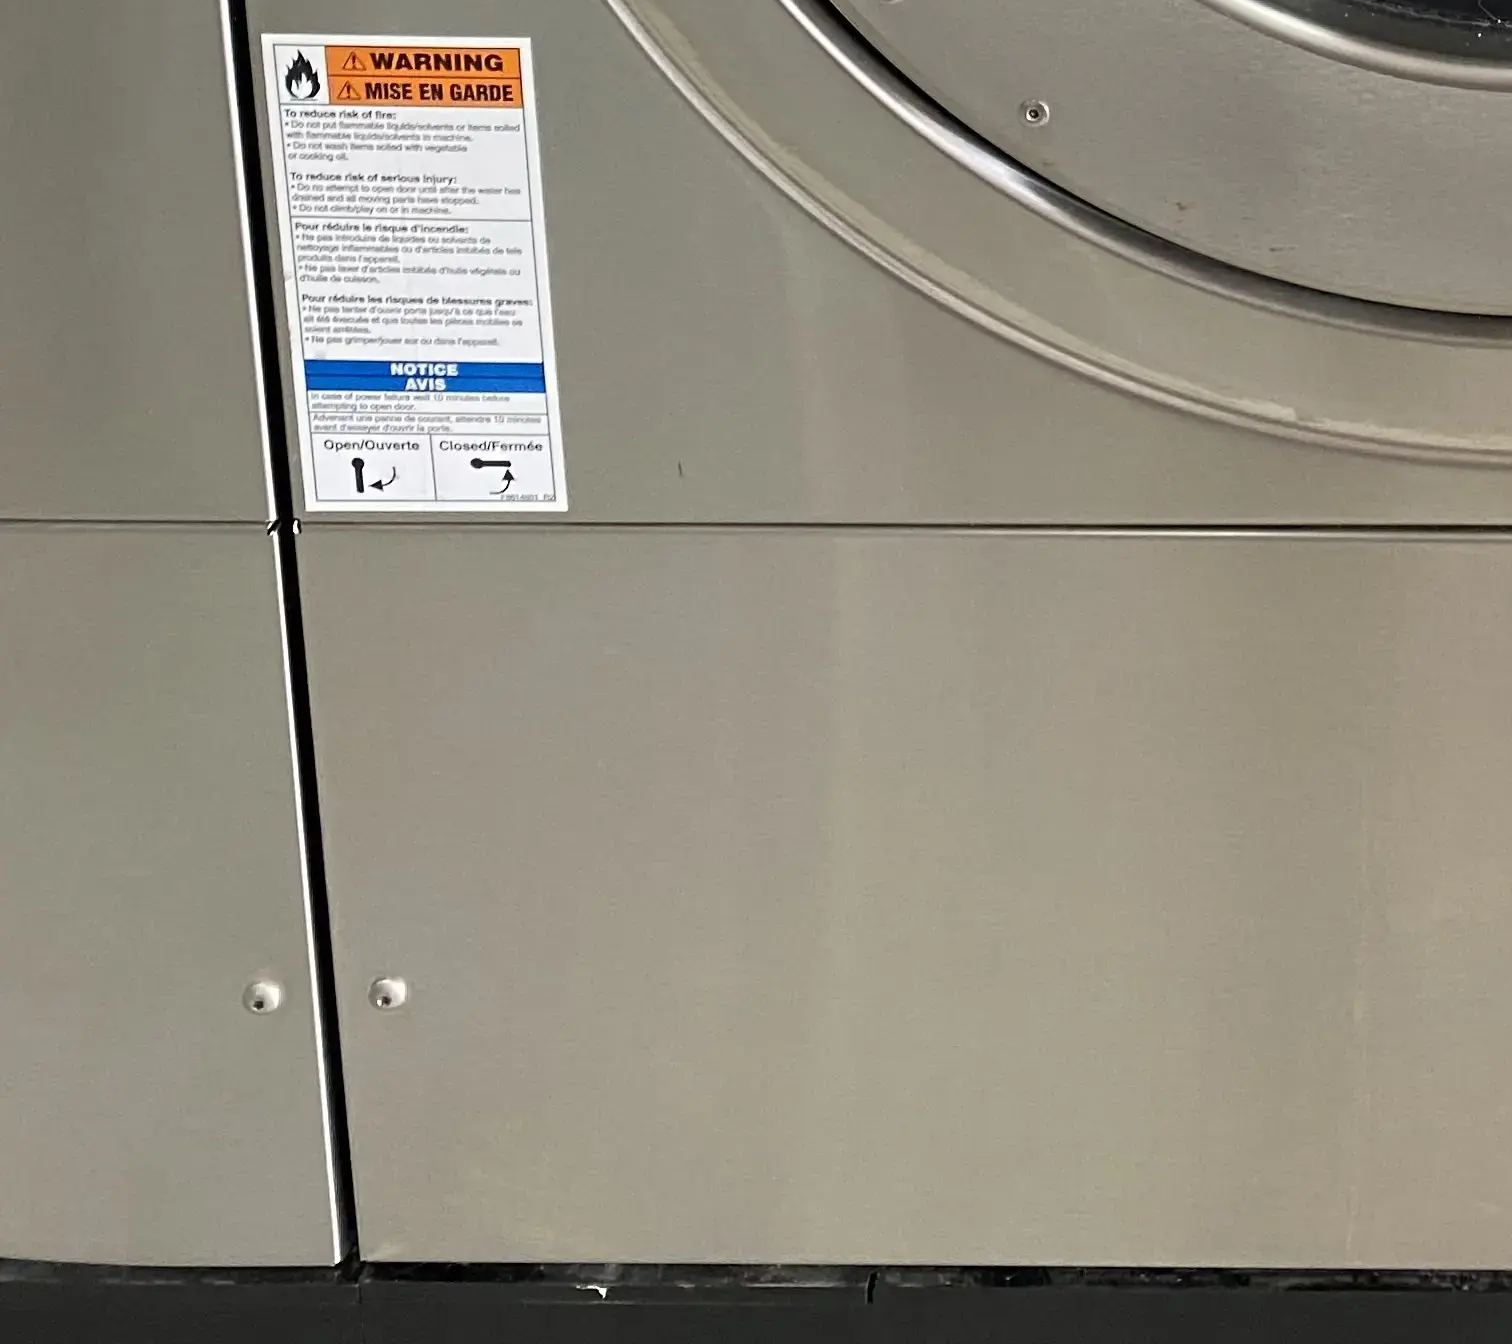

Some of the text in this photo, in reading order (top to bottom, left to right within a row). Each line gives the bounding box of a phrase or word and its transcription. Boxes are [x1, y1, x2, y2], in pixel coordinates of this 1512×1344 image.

[369, 52, 504, 73] WARNING
[365, 83, 514, 103] MISE EN GARDE
[283, 107, 297, 118] To
[298, 108, 336, 118] reduce
[338, 109, 359, 119] risk
[360, 109, 373, 119] of
[290, 119, 304, 128] Do
[321, 121, 336, 130] put
[288, 170, 303, 181] To
[304, 171, 342, 181] reduce
[343, 171, 365, 181] risk
[365, 172, 379, 182] of
[379, 173, 420, 183] serious
[296, 182, 310, 191] Do
[298, 203, 312, 212] Do
[294, 221, 320, 231] Pour
[361, 222, 372, 232] le
[373, 223, 408, 234] risque
[300, 292, 326, 303] Pour
[425, 295, 440, 304] de
[389, 362, 460, 378] NOTICE
[404, 377, 448, 393] AVIS
[323, 439, 421, 454] Open/Ouverte
[438, 438, 544, 453] Closed/Fermée
